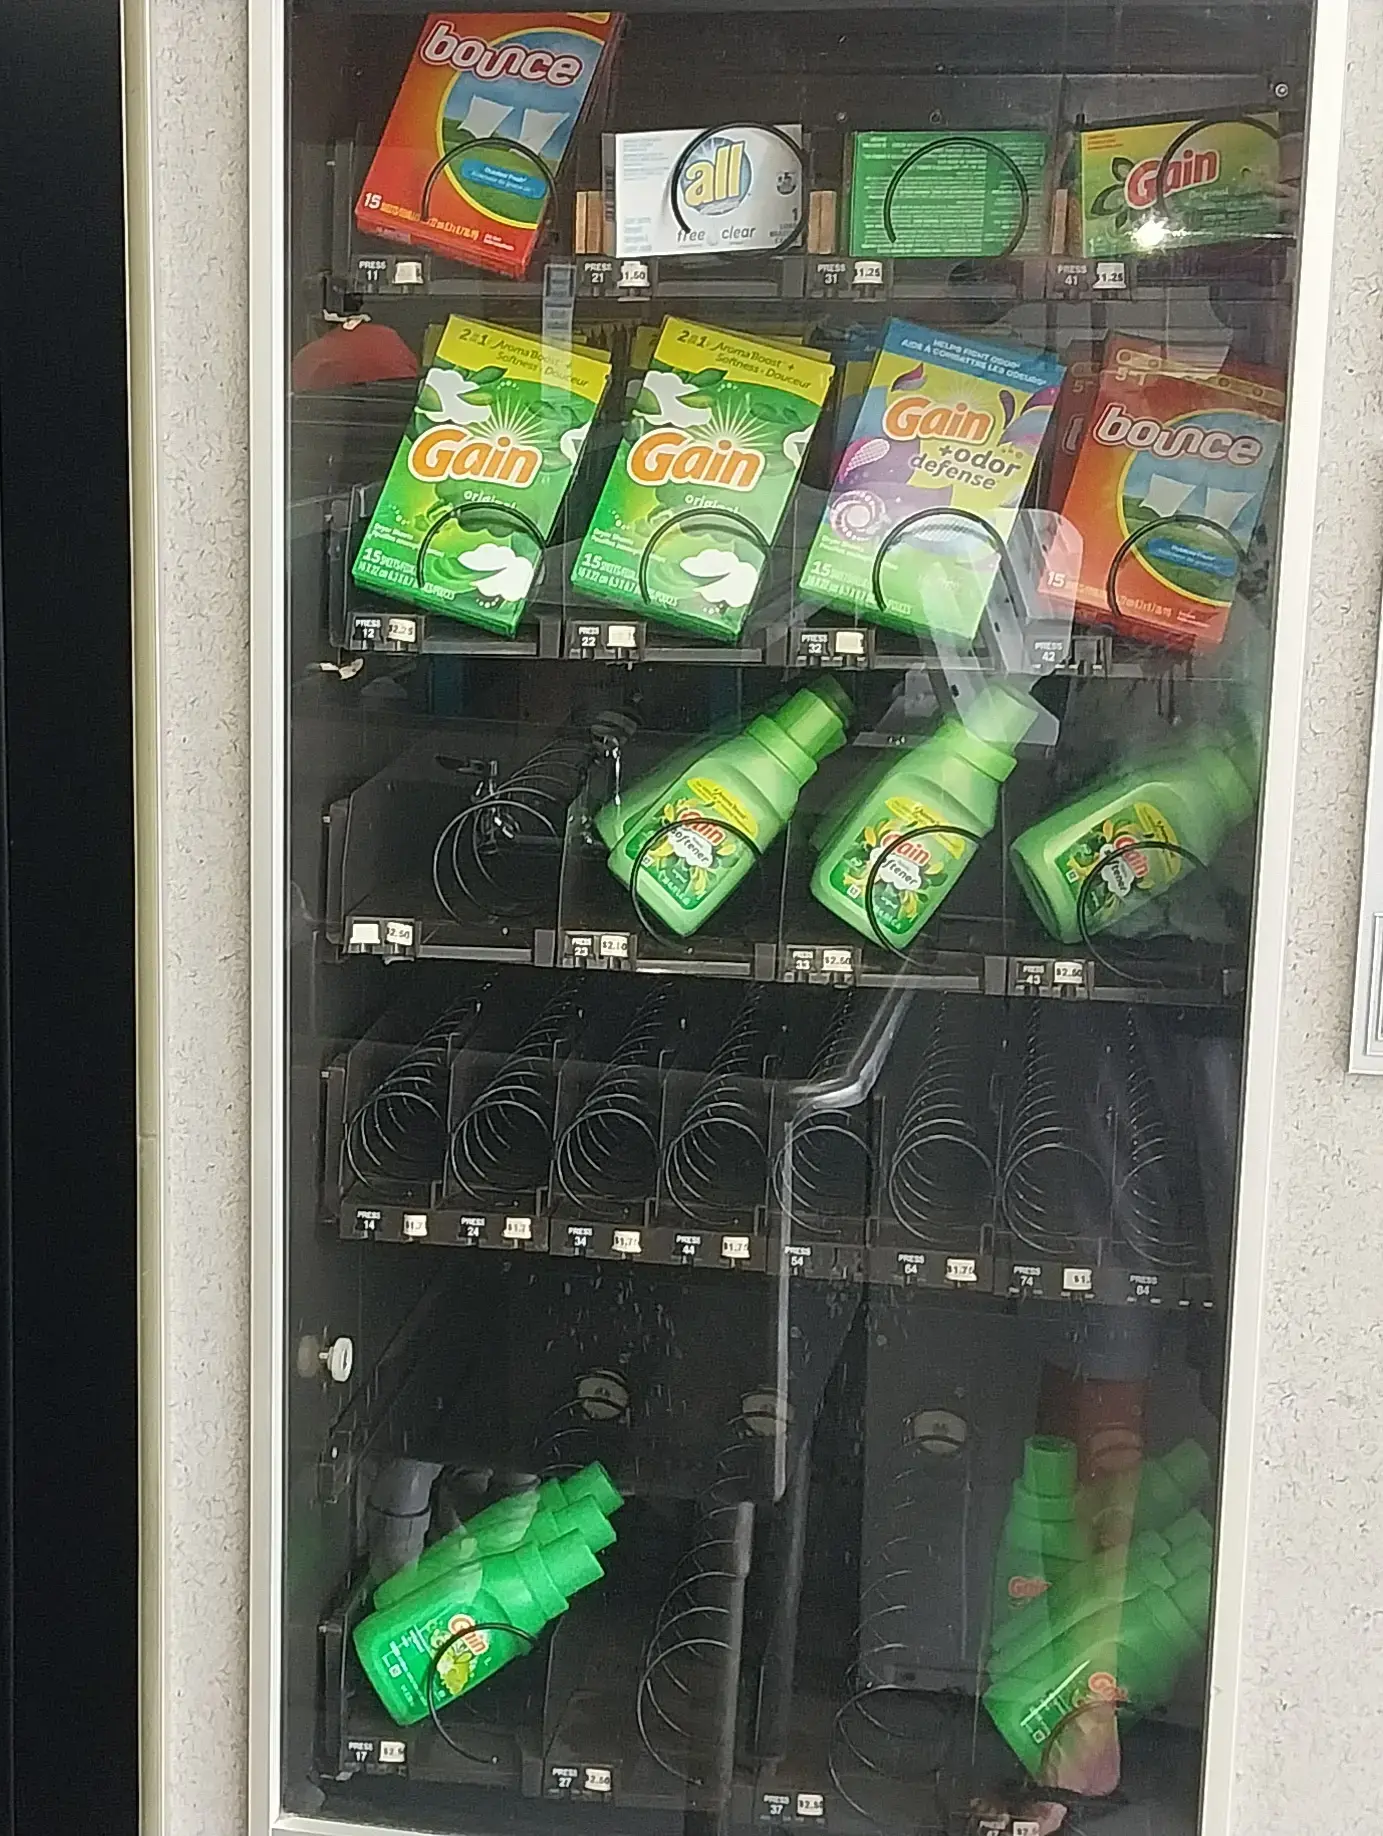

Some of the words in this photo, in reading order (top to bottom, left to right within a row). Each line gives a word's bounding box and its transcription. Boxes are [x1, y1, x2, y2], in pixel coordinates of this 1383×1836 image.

[420, 20, 583, 88] bounce
[684, 140, 746, 207] all
[1125, 149, 1221, 210] Gain
[364, 193, 382, 209] 15
[721, 226, 757, 240] clear
[358, 260, 387, 270] PRESS
[584, 263, 613, 272] PRESS
[817, 263, 846, 273] PRESS
[1057, 264, 1087, 275] PRESS
[367, 269, 378, 281] 11
[591, 272, 604, 283] 21
[824, 273, 838, 285] 31
[1065, 275, 1078, 286] 41
[765, 367, 812, 389] Douceur
[882, 396, 996, 446] Gain
[1093, 403, 1264, 466] bounce
[409, 424, 543, 488] Gain
[627, 428, 766, 492] Gain
[910, 453, 996, 490] defense
[362, 547, 383, 563] 15
[581, 552, 602, 568] 15
[810, 560, 832, 577] 15
[1046, 571, 1065, 587] 15
[355, 618, 382, 628] PRESS
[362, 628, 375, 639] 12
[801, 634, 828, 644] PRESS
[581, 636, 596, 647] 22
[808, 643, 822, 655] 32
[1042, 651, 1056, 663] 42
[1026, 974, 1041, 985] 43
[356, 1211, 381, 1220] PRESS
[363, 1220, 375, 1231] 14
[460, 1217, 486, 1227] PRESS
[467, 1226, 480, 1237] 24
[568, 1226, 593, 1237] PRESS
[574, 1236, 587, 1247] 34
[676, 1234, 702, 1245] PRESS
[682, 1245, 696, 1256] 44
[784, 1245, 812, 1257] PRESS
[790, 1256, 804, 1267] 54
[898, 1253, 925, 1265] PRESS
[1013, 1266, 1042, 1277] PRESS
[1019, 1275, 1034, 1287] 74
[1129, 1274, 1158, 1286] PRESS
[348, 1741, 374, 1752] PRESS
[355, 1751, 367, 1762] 17
[552, 1767, 579, 1778] PRESS
[558, 1777, 573, 1788] 27
[770, 1803, 784, 1815] 37
